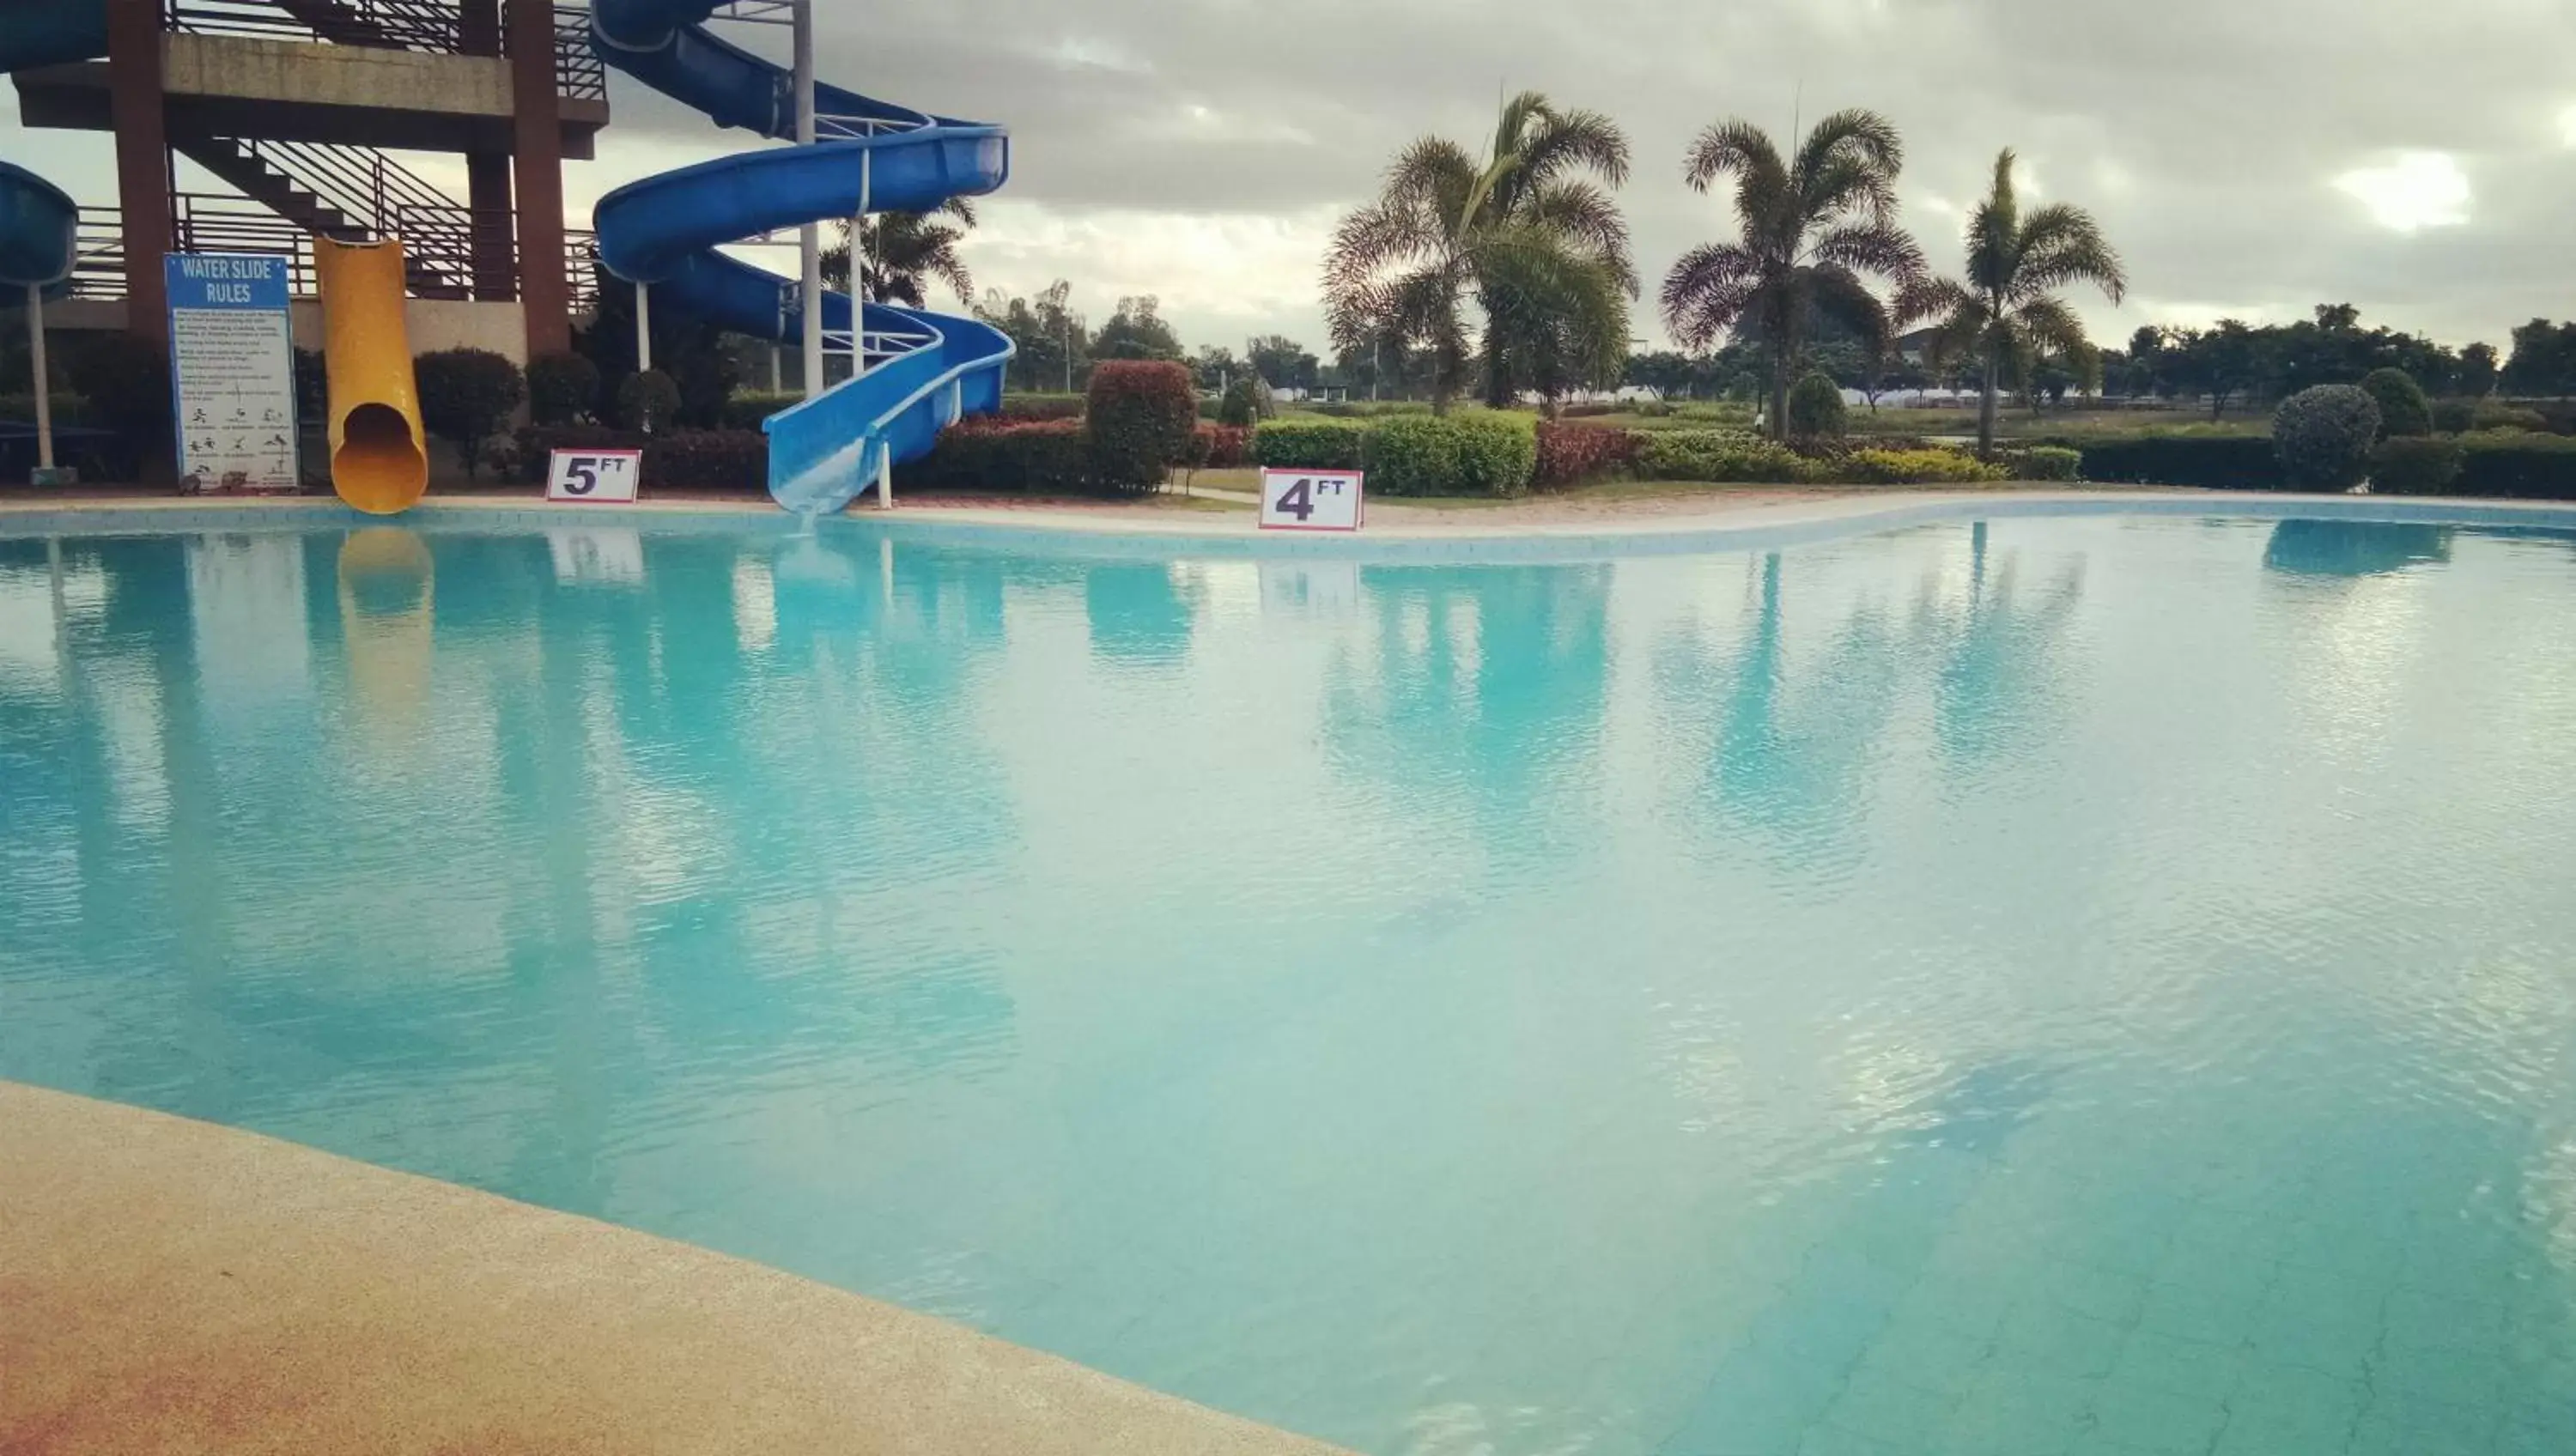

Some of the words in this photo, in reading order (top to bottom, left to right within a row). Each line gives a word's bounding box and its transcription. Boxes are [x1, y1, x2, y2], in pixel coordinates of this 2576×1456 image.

[181, 258, 229, 277] WATER
[231, 260, 272, 279] SLIDE
[207, 282, 251, 303] RULES
[563, 458, 596, 494] 5
[601, 458, 627, 472] FT
[1276, 479, 1314, 521] 4
[1317, 480, 1346, 495] FT
